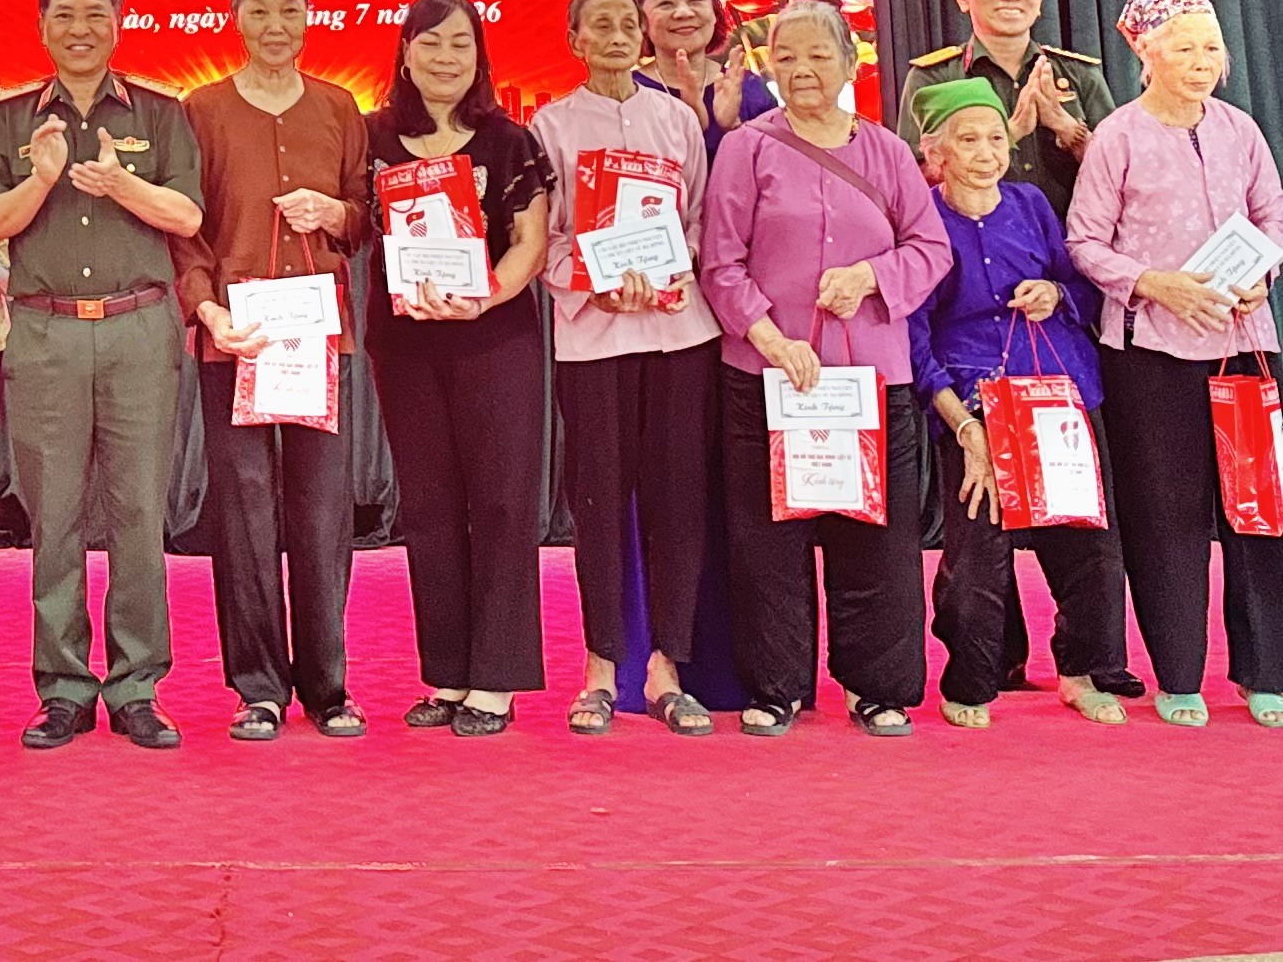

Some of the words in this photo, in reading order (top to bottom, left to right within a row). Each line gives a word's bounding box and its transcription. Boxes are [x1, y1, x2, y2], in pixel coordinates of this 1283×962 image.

[122, 8, 161, 33] ào,
[169, 6, 229, 34] ngày
[307, 3, 347, 31] áng
[355, 3, 371, 25] 7
[377, 3, 410, 25] nă
[474, 0, 502, 23] 26
